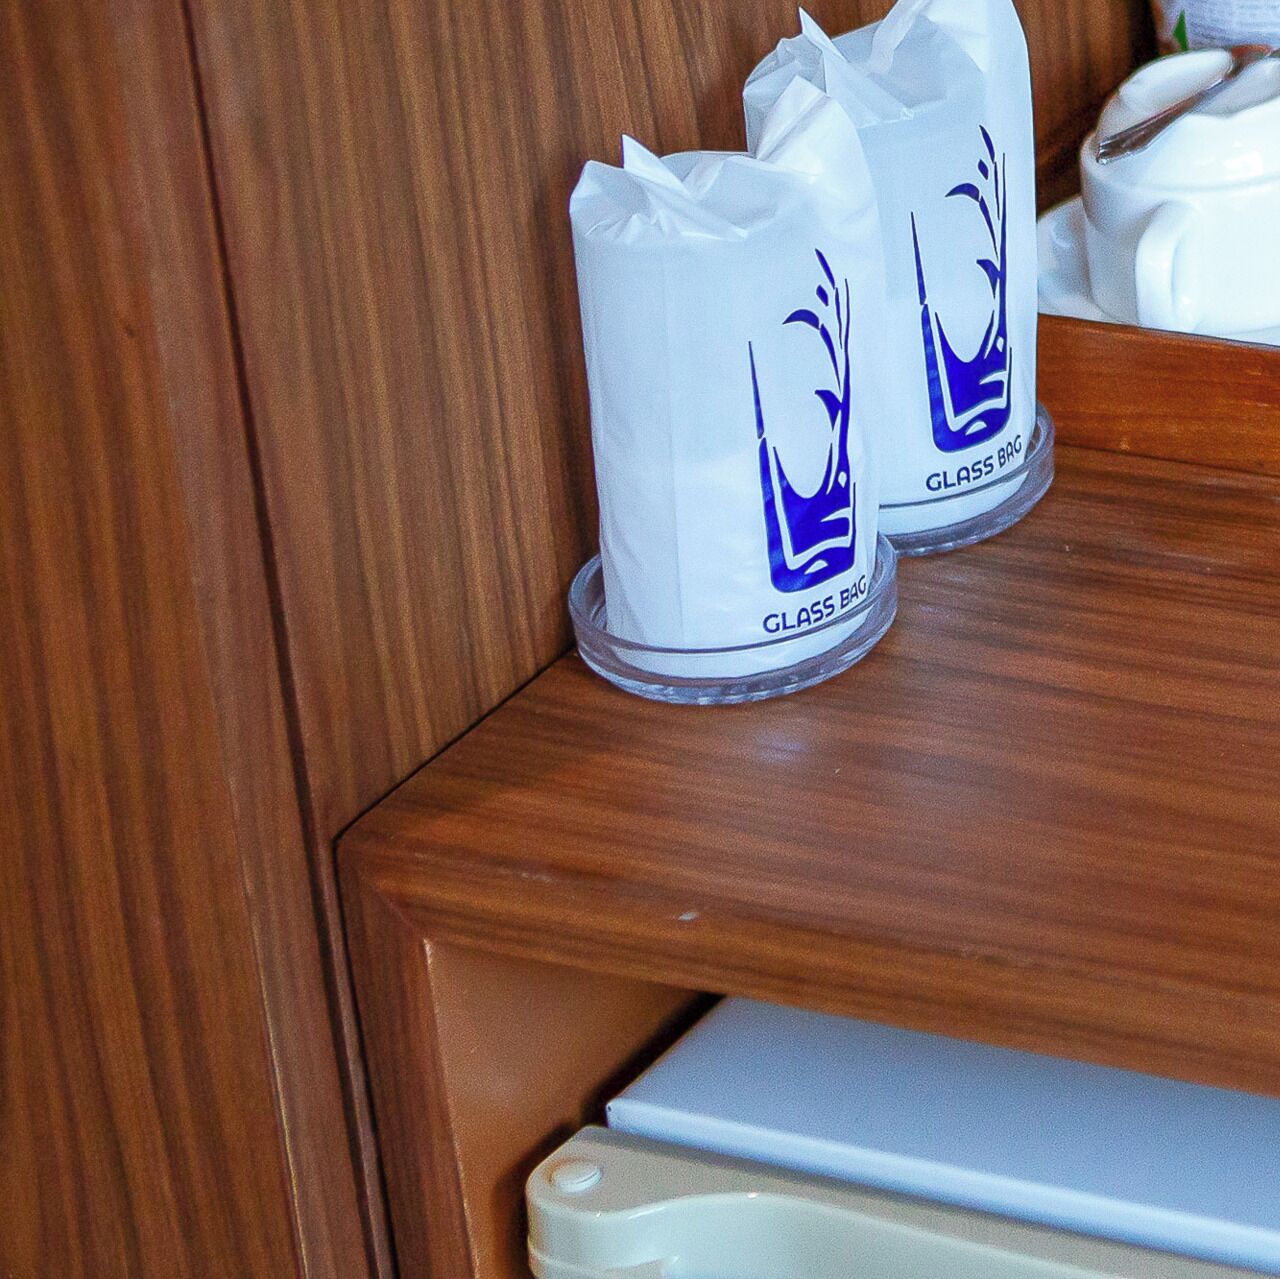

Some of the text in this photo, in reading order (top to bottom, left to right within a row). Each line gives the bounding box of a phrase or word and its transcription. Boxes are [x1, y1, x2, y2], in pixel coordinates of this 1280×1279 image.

[926, 434, 1022, 491] GLASS BAG
[763, 575, 866, 633] GLASS BAG
